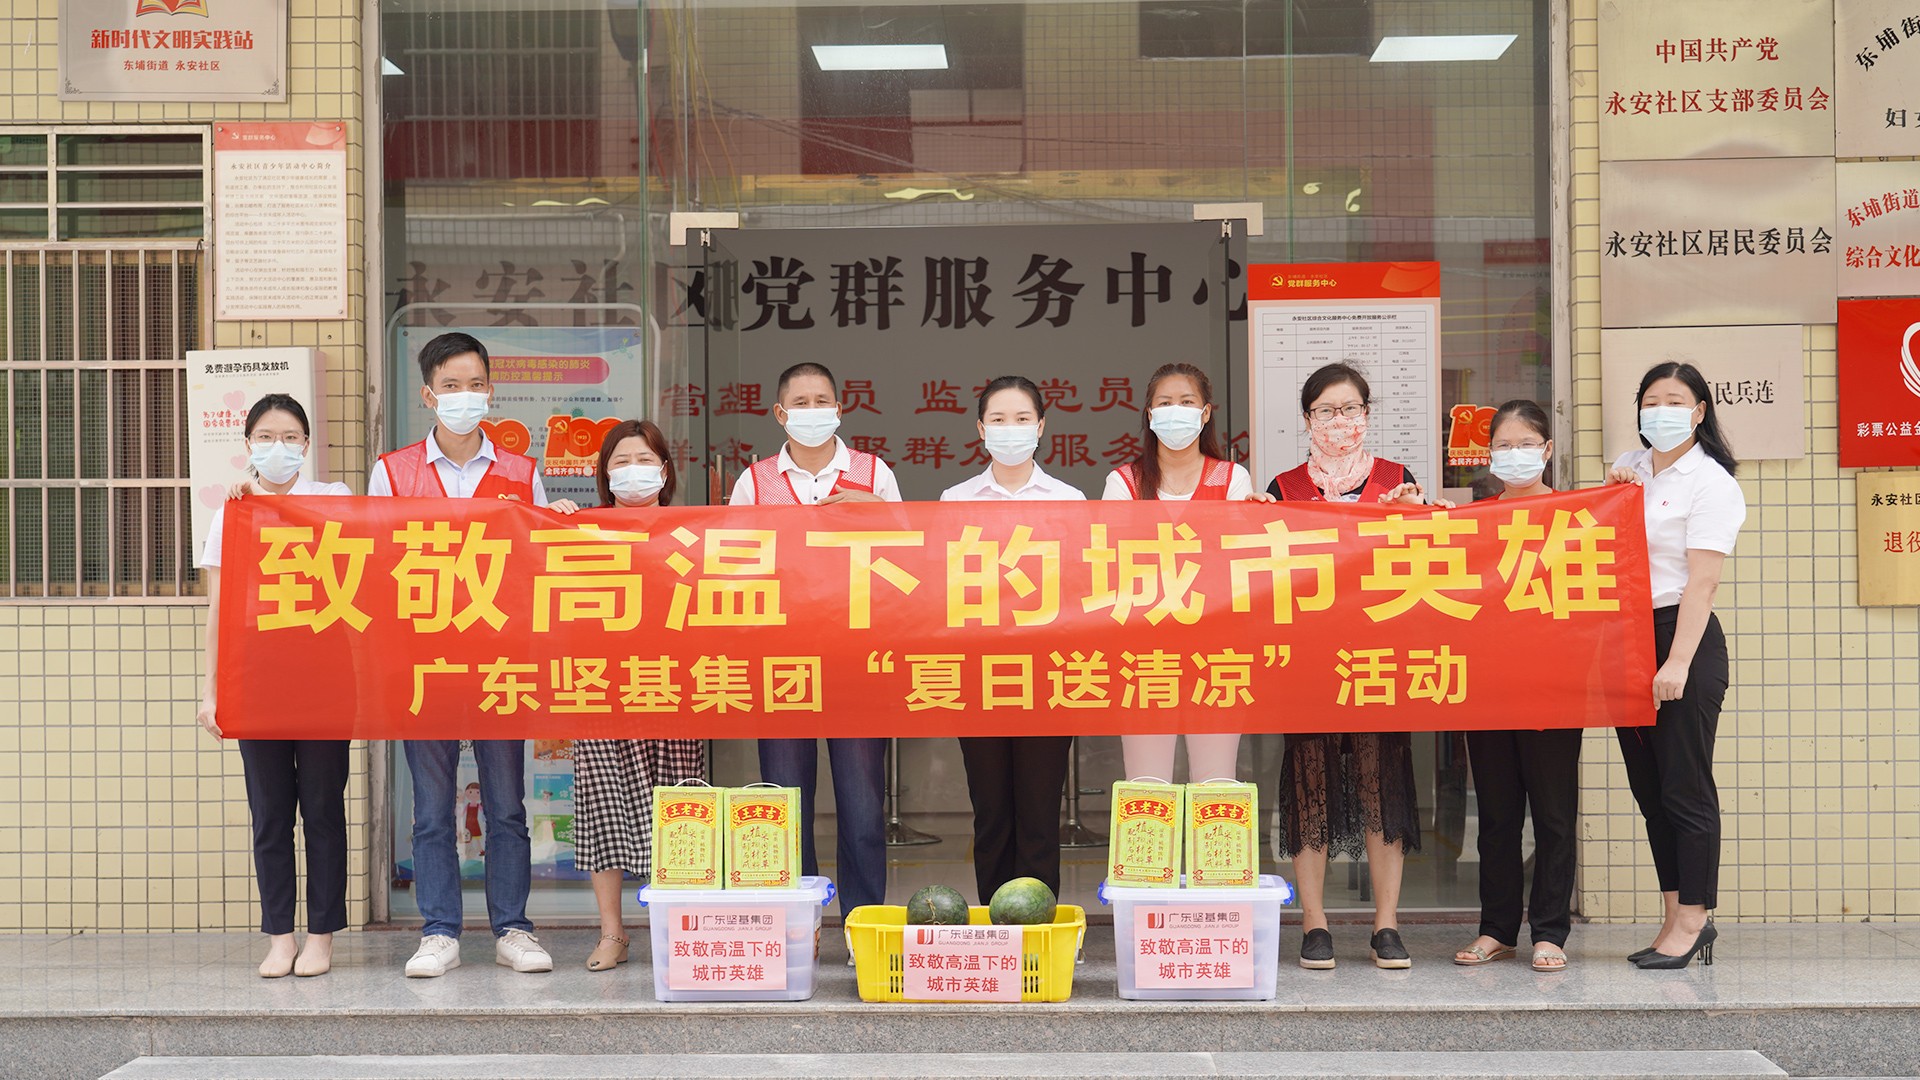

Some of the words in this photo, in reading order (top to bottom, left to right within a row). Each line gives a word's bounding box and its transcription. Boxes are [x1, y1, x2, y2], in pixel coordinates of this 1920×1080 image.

[91, 29, 254, 50] 新时代文明实践站
[1656, 36, 1780, 64] 中国共产党
[123, 59, 170, 72] 东埔街道
[175, 59, 221, 72] 永安社区
[1604, 86, 1830, 116] 永安社区支部委员会
[1844, 188, 1920, 229] 东埔街道
[1604, 226, 1834, 258] 永安社区居民委员会
[1287, 279, 1338, 288] 党群服务中心
[204, 361, 290, 375] 免费避孕药具发放机
[914, 376, 1140, 415] 监党员
[258, 506, 1622, 635] 致敬高温下的城市英雄
[670, 803, 705, 817] 王老吉
[741, 806, 776, 820] 王老吉
[1129, 801, 1165, 816] 王老吉
[1204, 804, 1240, 819] 王老吉
[702, 914, 773, 925] 广东坚基集团
[1168, 911, 1240, 923] 广东坚基集团
[938, 929, 1009, 940] 广东坚基集团
[674, 940, 781, 957] 致敬高温下的
[1140, 938, 1249, 955] 致敬高温下的
[909, 953, 1017, 971] 致敬高温下的
[1159, 962, 1231, 979] 城市英雄
[692, 964, 764, 981] 城市英雄
[927, 976, 999, 993] 城市英雄
